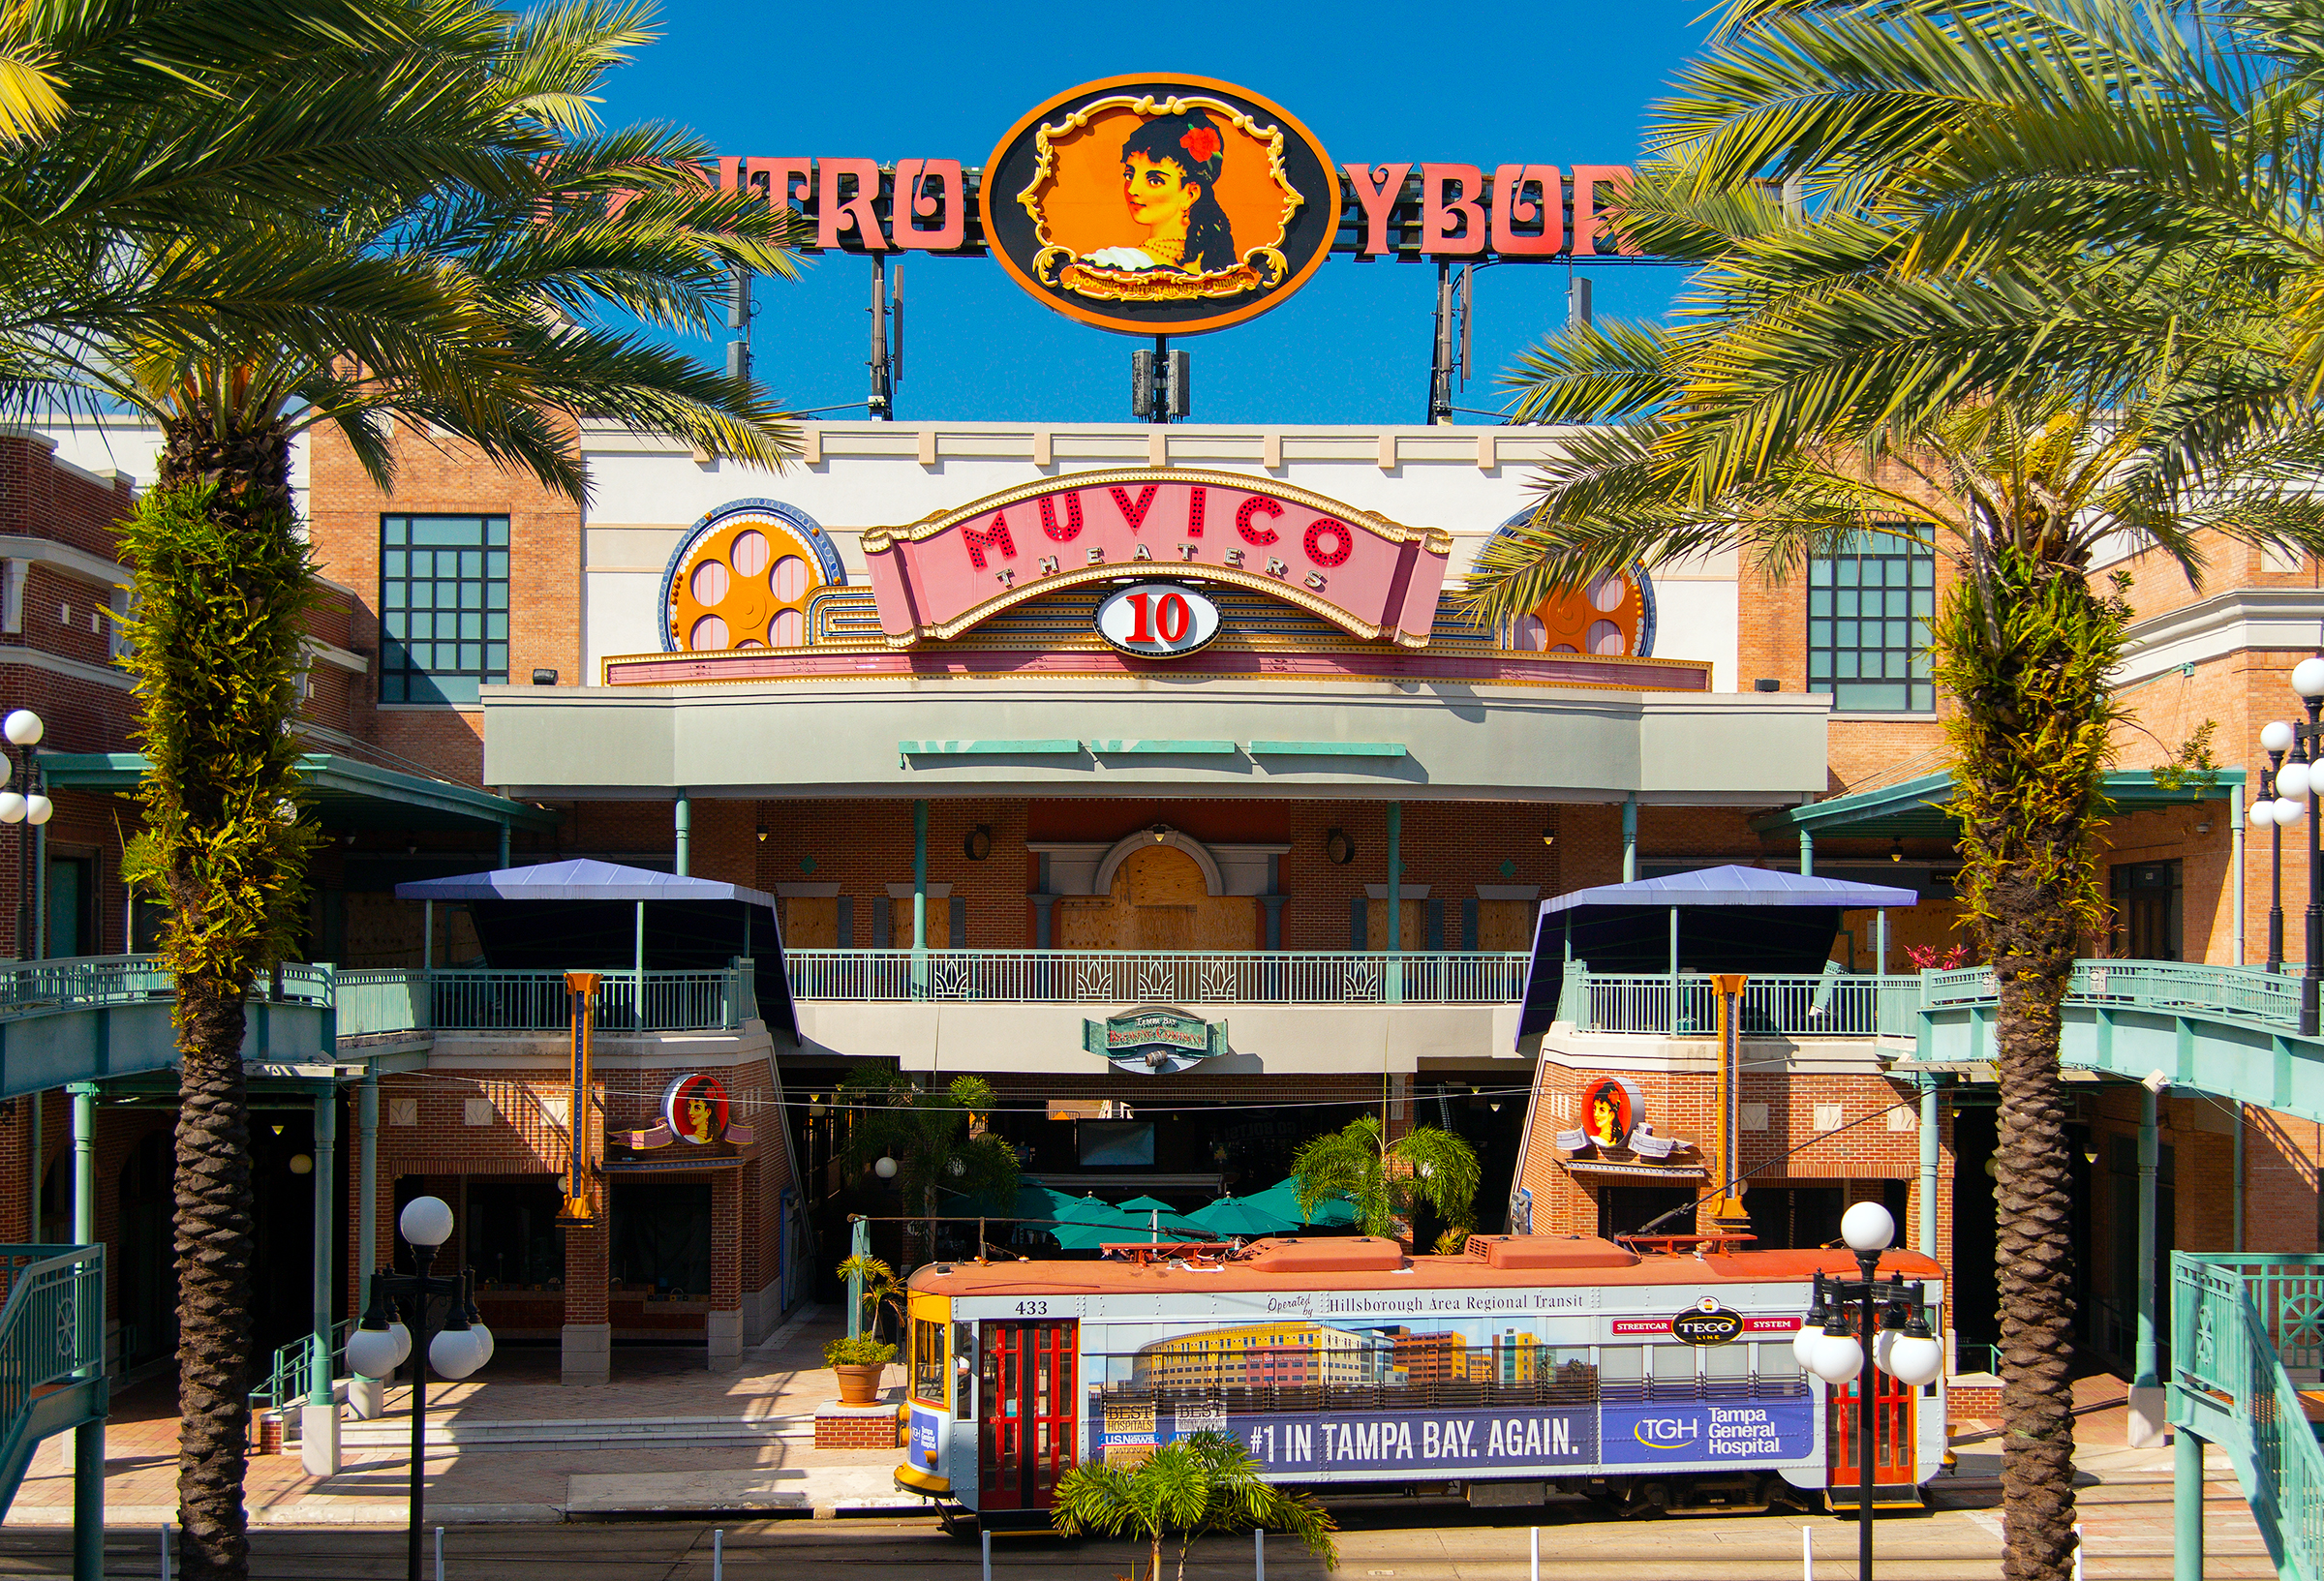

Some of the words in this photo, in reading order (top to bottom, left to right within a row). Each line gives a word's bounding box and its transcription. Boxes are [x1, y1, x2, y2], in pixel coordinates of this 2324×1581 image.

[1342, 162, 1644, 258] YBOR
[1072, 273, 1120, 291] SHOPPING
[1127, 284, 1206, 295] ENTERTAINMENT
[1212, 273, 1247, 291] DINING
[960, 485, 1354, 569] MUVICO
[995, 543, 1330, 590] THEATERS
[1124, 591, 1190, 645] 10
[1136, 1018, 1160, 1026] TAMPA
[1162, 1017, 1178, 1026] BAY
[1015, 1300, 1048, 1316] 433
[1268, 1293, 1311, 1314] Operated
[1302, 1307, 1314, 1319] by
[1330, 1297, 1423, 1314] Hillsborough
[1429, 1298, 1460, 1310] Area
[1466, 1295, 1528, 1312] Regional
[1534, 1294, 1583, 1308] Transit
[1679, 1323, 1734, 1333] TECO
[1108, 1405, 1152, 1419] BEST
[1178, 1404, 1223, 1418] BEST
[1708, 1407, 1767, 1424] Tampa
[1107, 1420, 1153, 1432] HOSPITALS
[1642, 1418, 1697, 1439] TGH
[1708, 1421, 1775, 1439] General
[1250, 1424, 1274, 1463] #1
[1285, 1423, 1312, 1462] IN
[1321, 1421, 1414, 1461] TAMPA
[1422, 1419, 1478, 1459] BAY.
[1487, 1417, 1579, 1457] AGAIN.
[1708, 1437, 1780, 1457] Hospital
